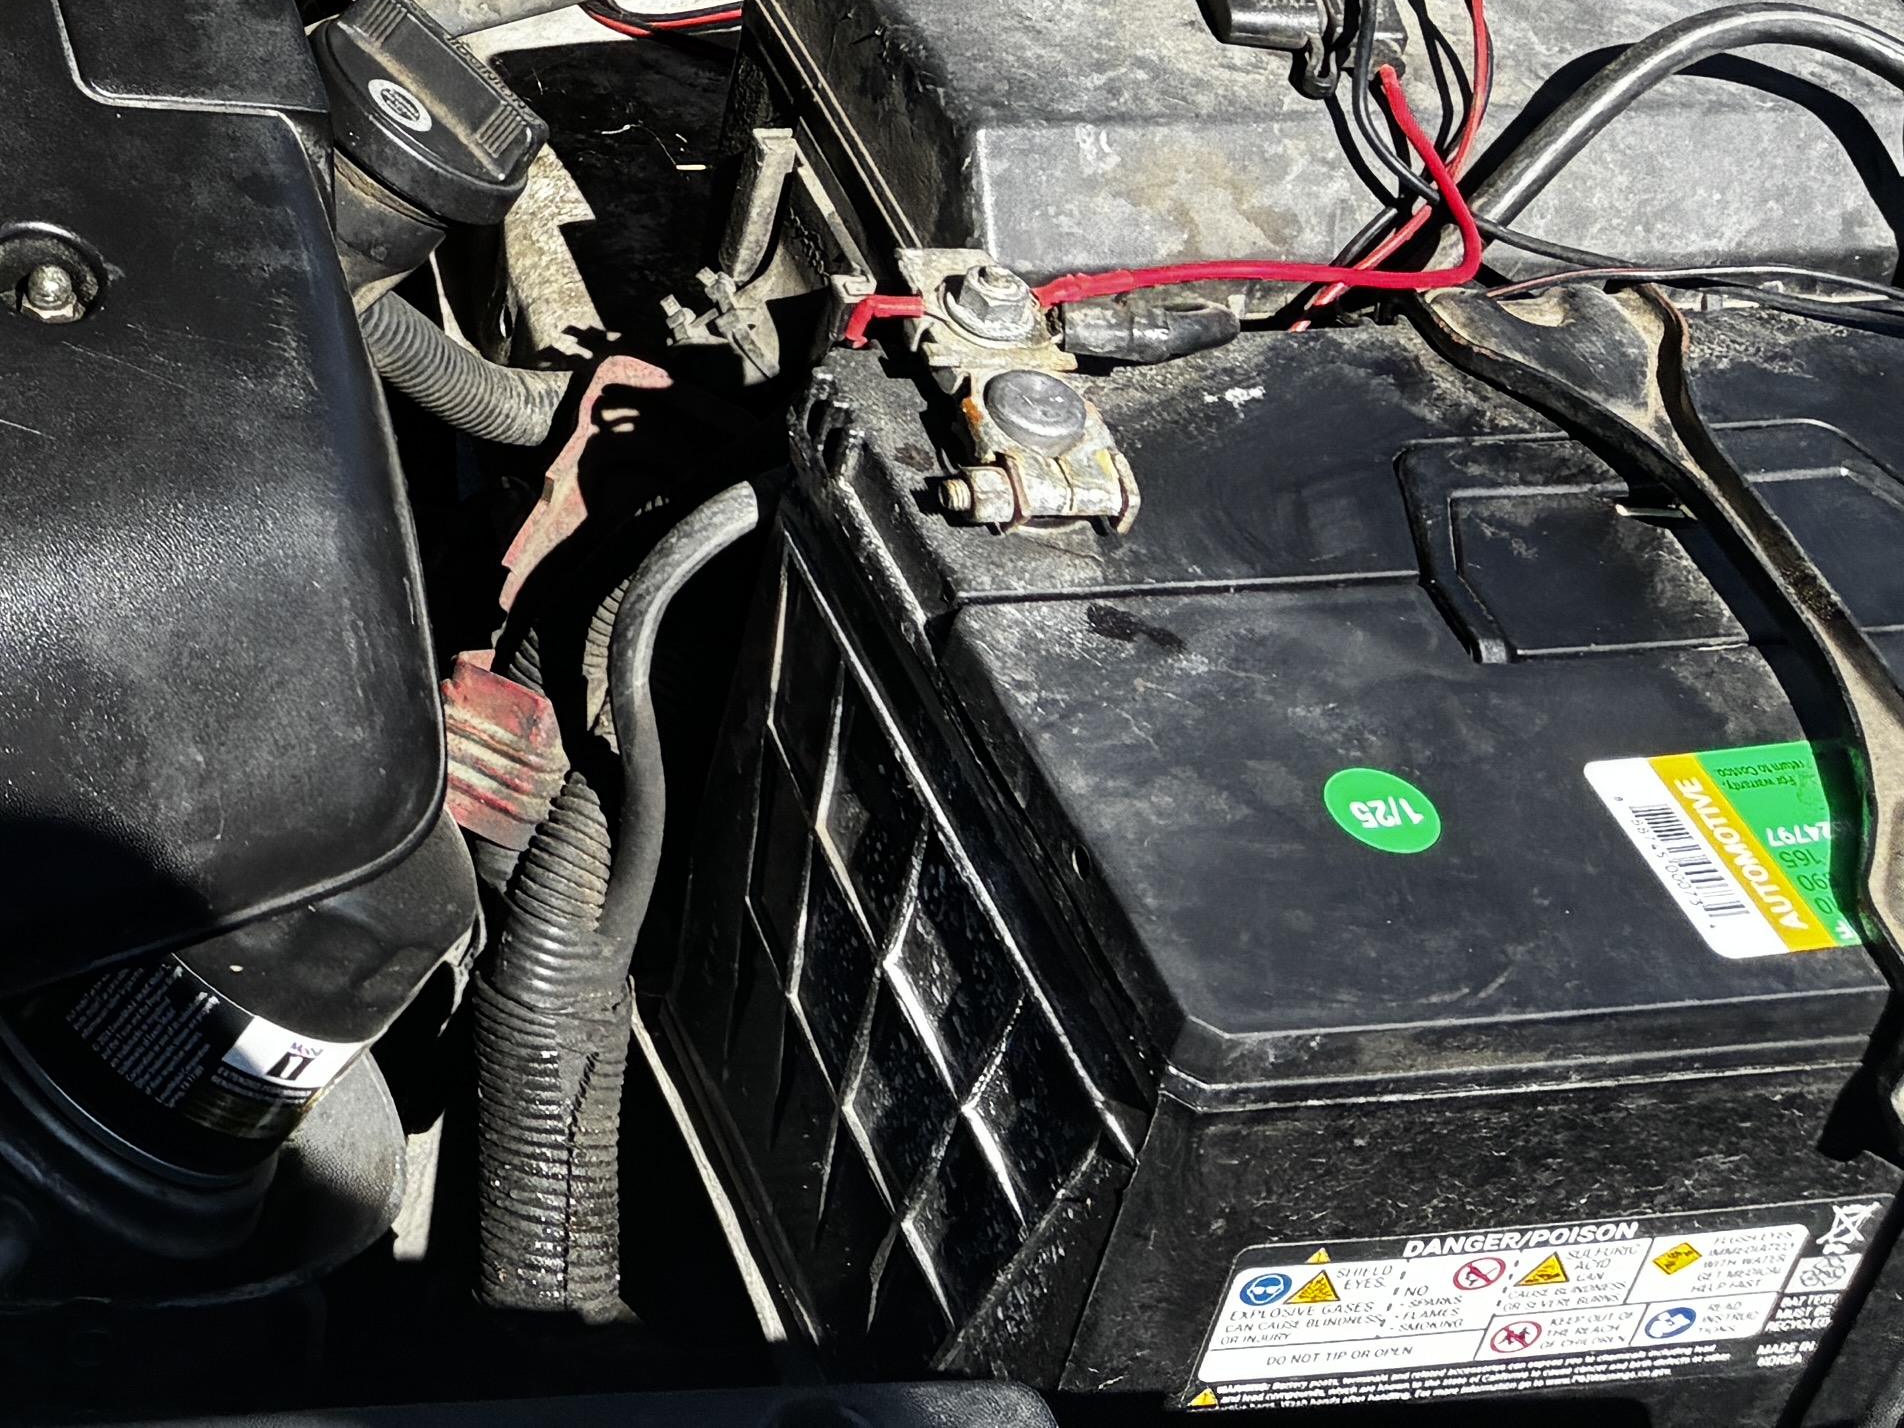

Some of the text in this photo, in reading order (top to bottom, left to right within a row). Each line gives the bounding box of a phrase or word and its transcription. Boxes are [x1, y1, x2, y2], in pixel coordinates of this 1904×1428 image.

[1349, 795, 1424, 829] 1/25
[1674, 776, 1809, 931] AUTOMOTIVE
[1402, 1221, 1639, 1258] DANGER/POISON
[1336, 1265, 1393, 1279] SHIELD
[1404, 1285, 1429, 1297] NO
[1230, 1301, 1375, 1321] EXPLOSIVE GASES
[1225, 1322, 1254, 1333] CAN
[1220, 1335, 1239, 1345] OR
[1756, 1341, 1795, 1355] MADE
[1266, 1346, 1413, 1366] DO NOT TIP OR OPEN
